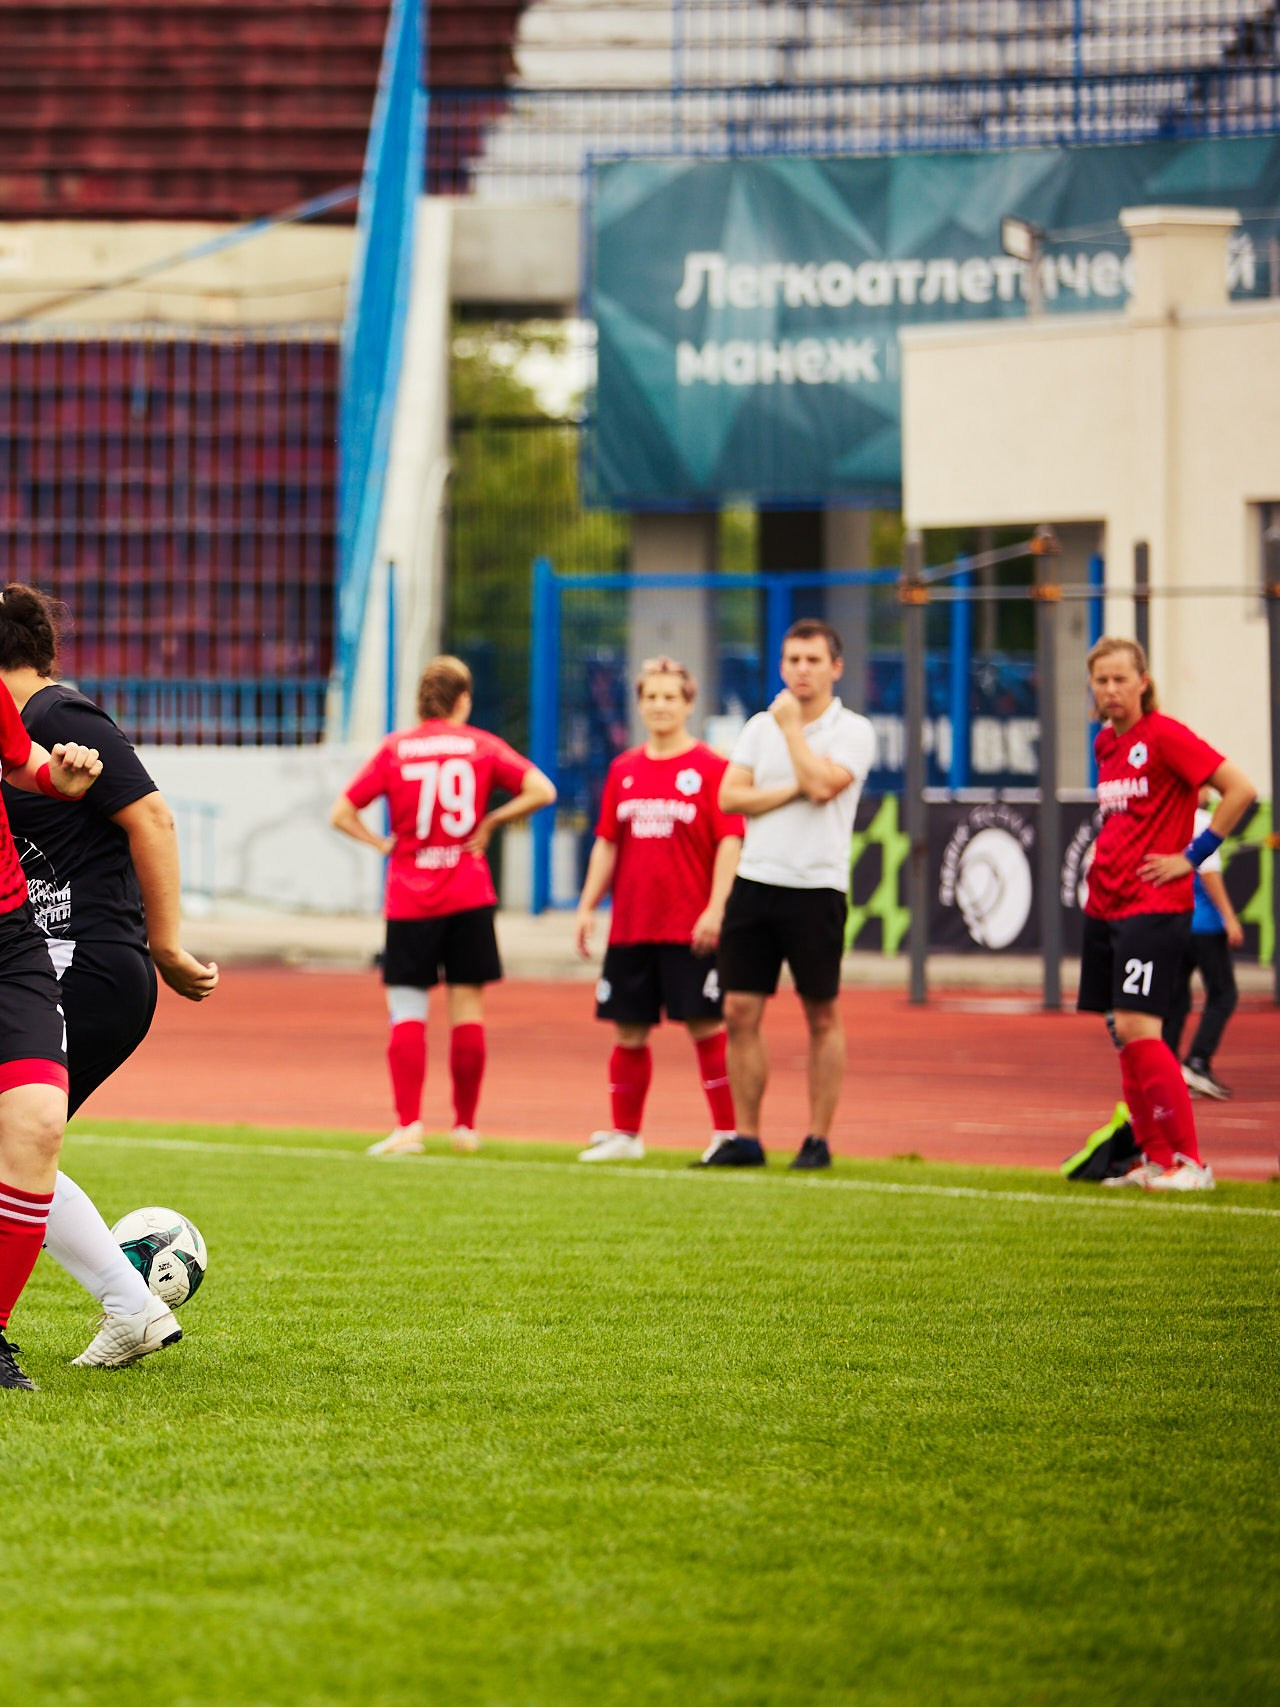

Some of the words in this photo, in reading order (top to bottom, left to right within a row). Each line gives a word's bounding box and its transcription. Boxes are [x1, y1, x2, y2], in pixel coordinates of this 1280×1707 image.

[677, 231, 1255, 308] Легкоатлетичей
[677, 338, 880, 386] манеж
[401, 758, 476, 840] 79
[1122, 958, 1153, 997] 21
